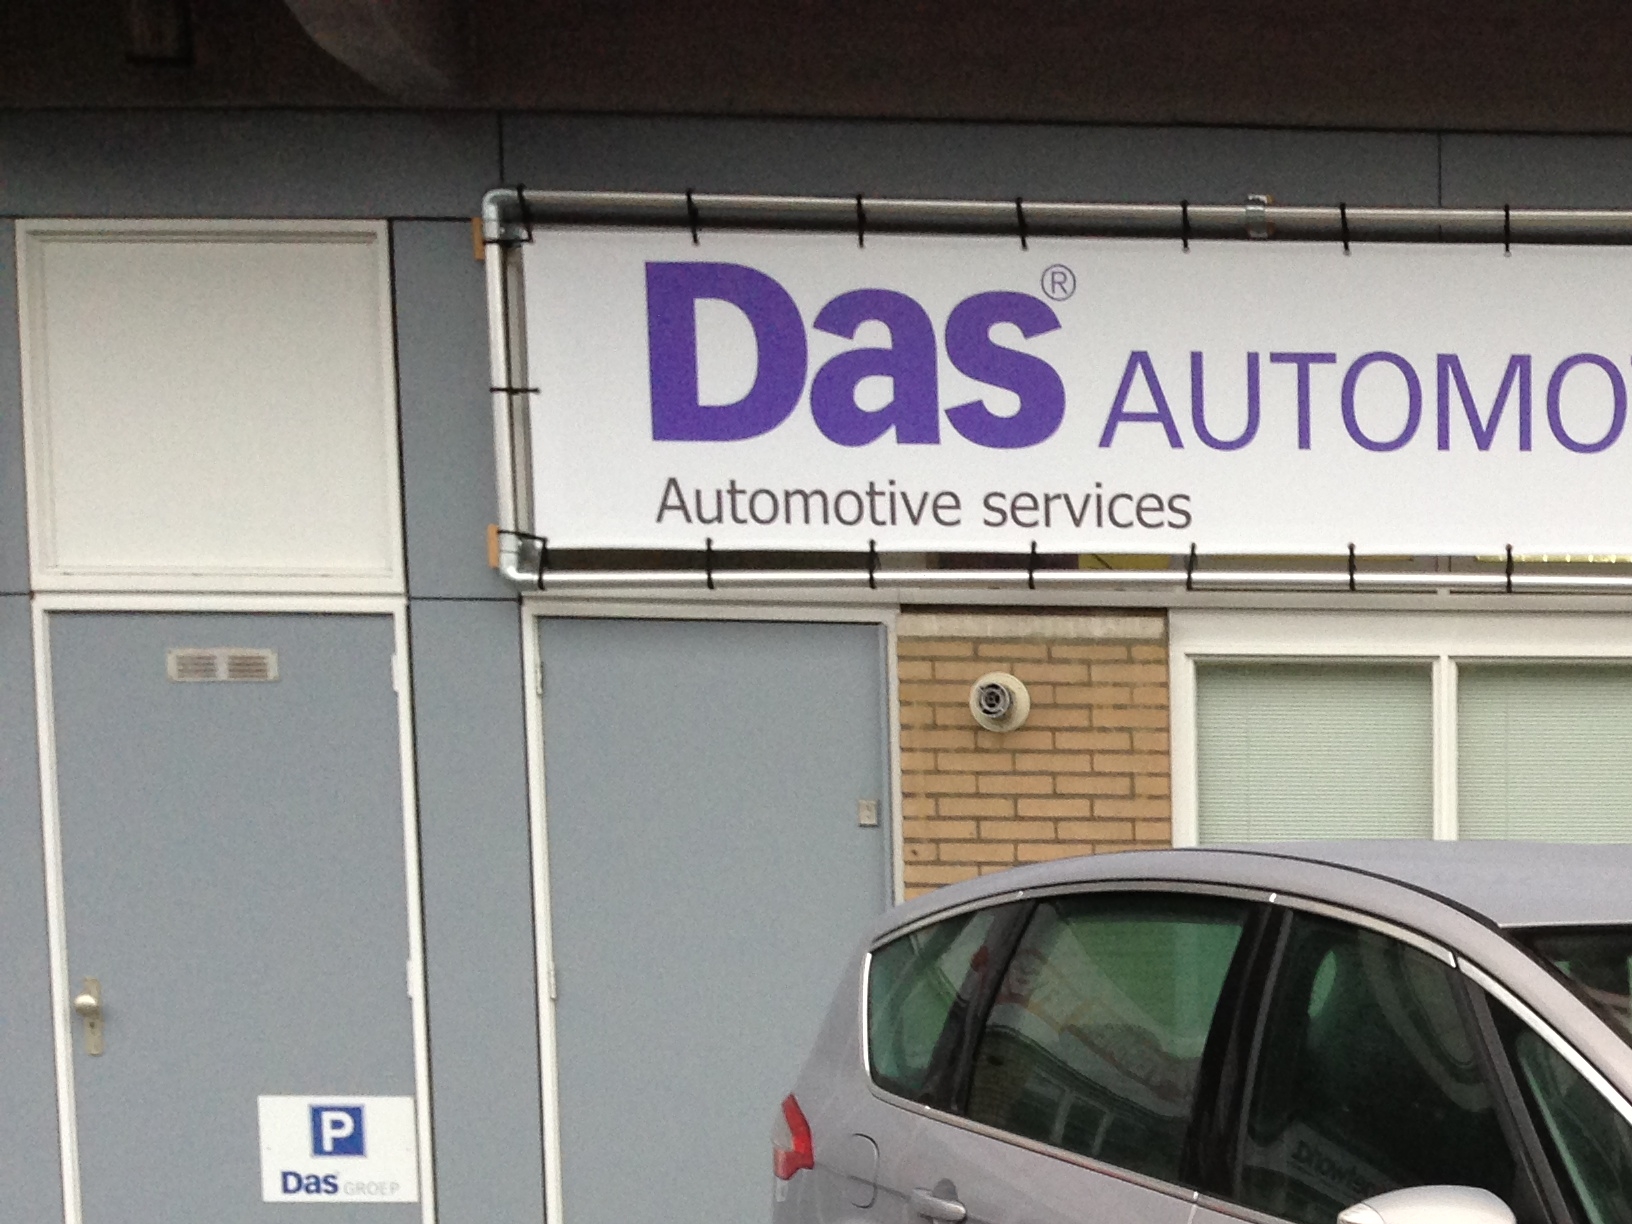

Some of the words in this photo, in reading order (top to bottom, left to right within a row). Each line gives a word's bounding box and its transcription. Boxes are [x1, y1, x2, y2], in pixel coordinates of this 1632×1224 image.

[645, 261, 1067, 449] Das
[656, 476, 962, 527] Automotive
[982, 482, 1193, 529] services
[320, 1110, 355, 1152] P
[281, 1170, 339, 1194] Das
[343, 1180, 400, 1196] GROEP
